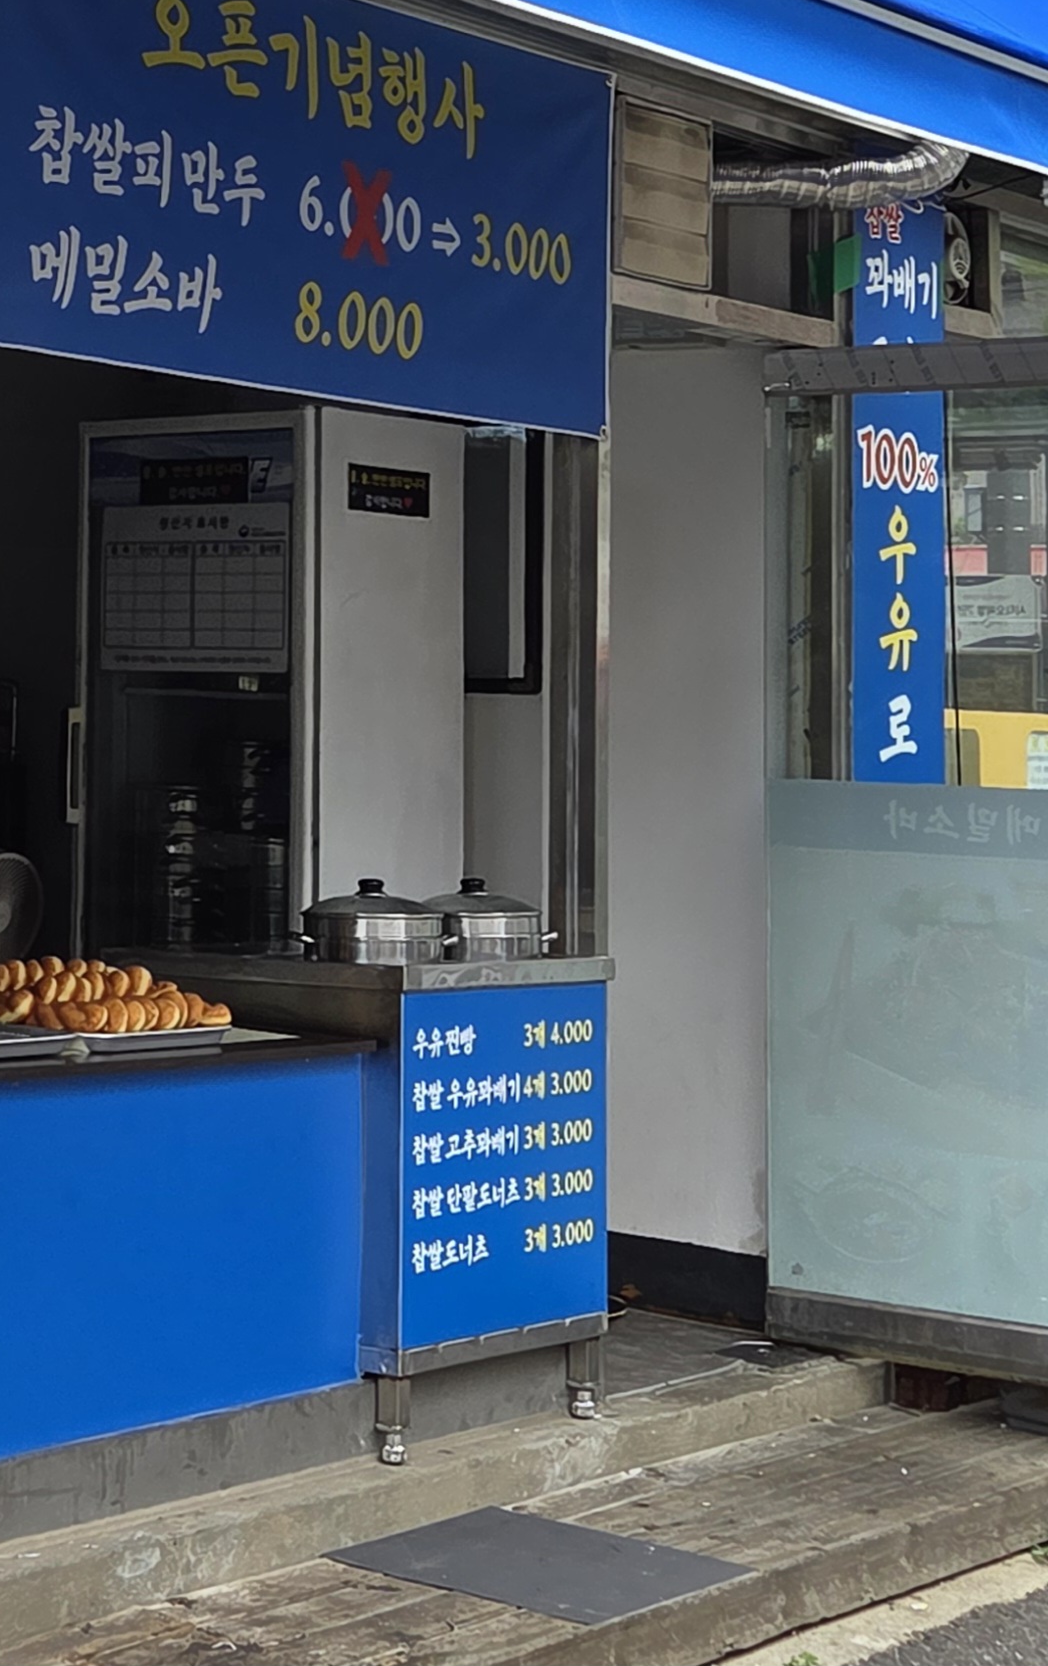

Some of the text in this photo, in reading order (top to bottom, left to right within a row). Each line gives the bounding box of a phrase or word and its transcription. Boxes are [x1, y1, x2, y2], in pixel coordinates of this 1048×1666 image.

[471, 213, 572, 285] 3.000
[29, 225, 424, 360] 메밀소바 8.000
[865, 248, 938, 320] 꽈배기
[856, 423, 939, 494] 100%
[523, 1019, 546, 1049] 3개
[550, 1019, 593, 1046] 4.000
[412, 1068, 593, 1112] 찹쌀 우유꽈배기 4개 3.000
[523, 1121, 546, 1150] 3개
[550, 1118, 593, 1146] 3.000
[412, 1185, 445, 1220] 찹쌀
[523, 1171, 546, 1201] 3개
[550, 1168, 593, 1196] 3.000
[524, 1223, 547, 1253] 3개
[551, 1218, 594, 1249] 3.000
